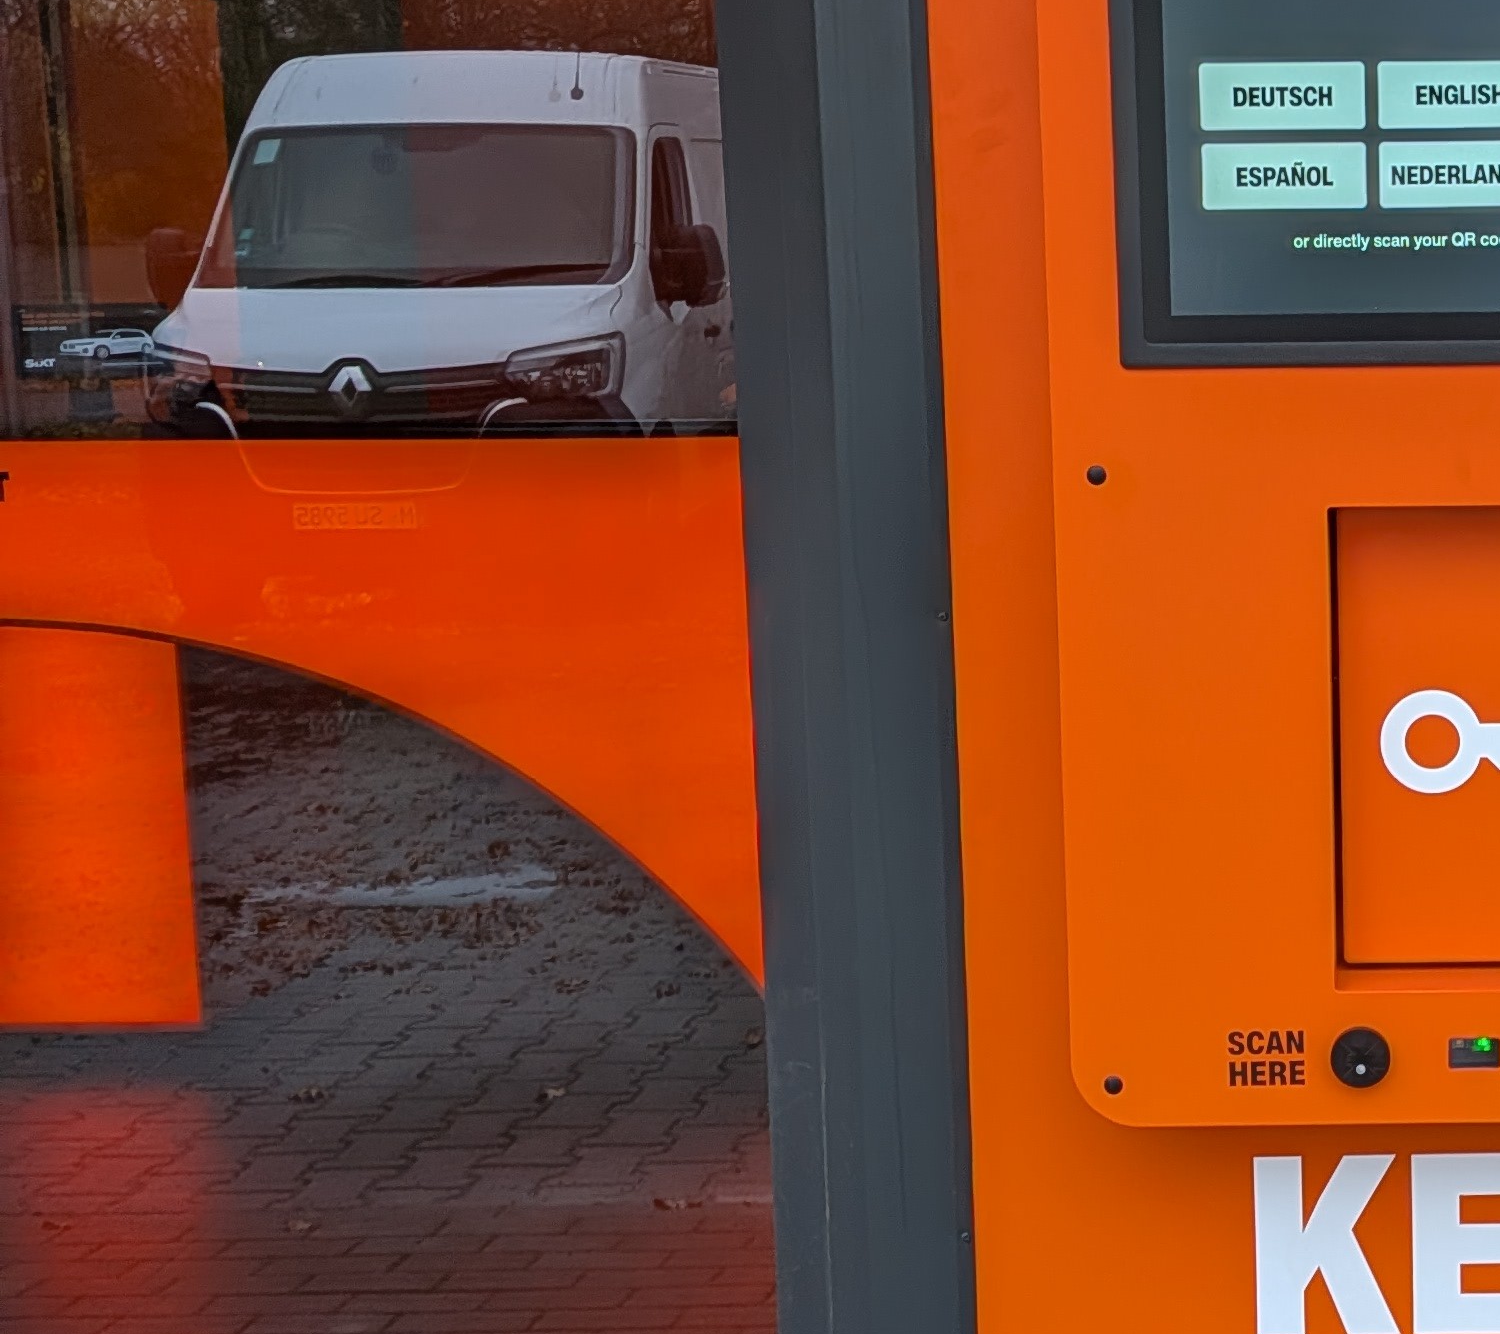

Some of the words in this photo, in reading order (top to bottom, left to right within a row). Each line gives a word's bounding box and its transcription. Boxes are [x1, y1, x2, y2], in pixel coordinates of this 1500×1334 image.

[1232, 85, 1333, 108] DEUTSCH
[1235, 162, 1334, 187] ESPAÑOL
[1293, 237, 1310, 249] or
[1314, 234, 1369, 251] directly
[1373, 235, 1409, 248] scan
[1414, 236, 1448, 250] your
[1451, 232, 1476, 247] QR
[1227, 1030, 1305, 1055] SCAN
[1228, 1060, 1306, 1087] HERE
